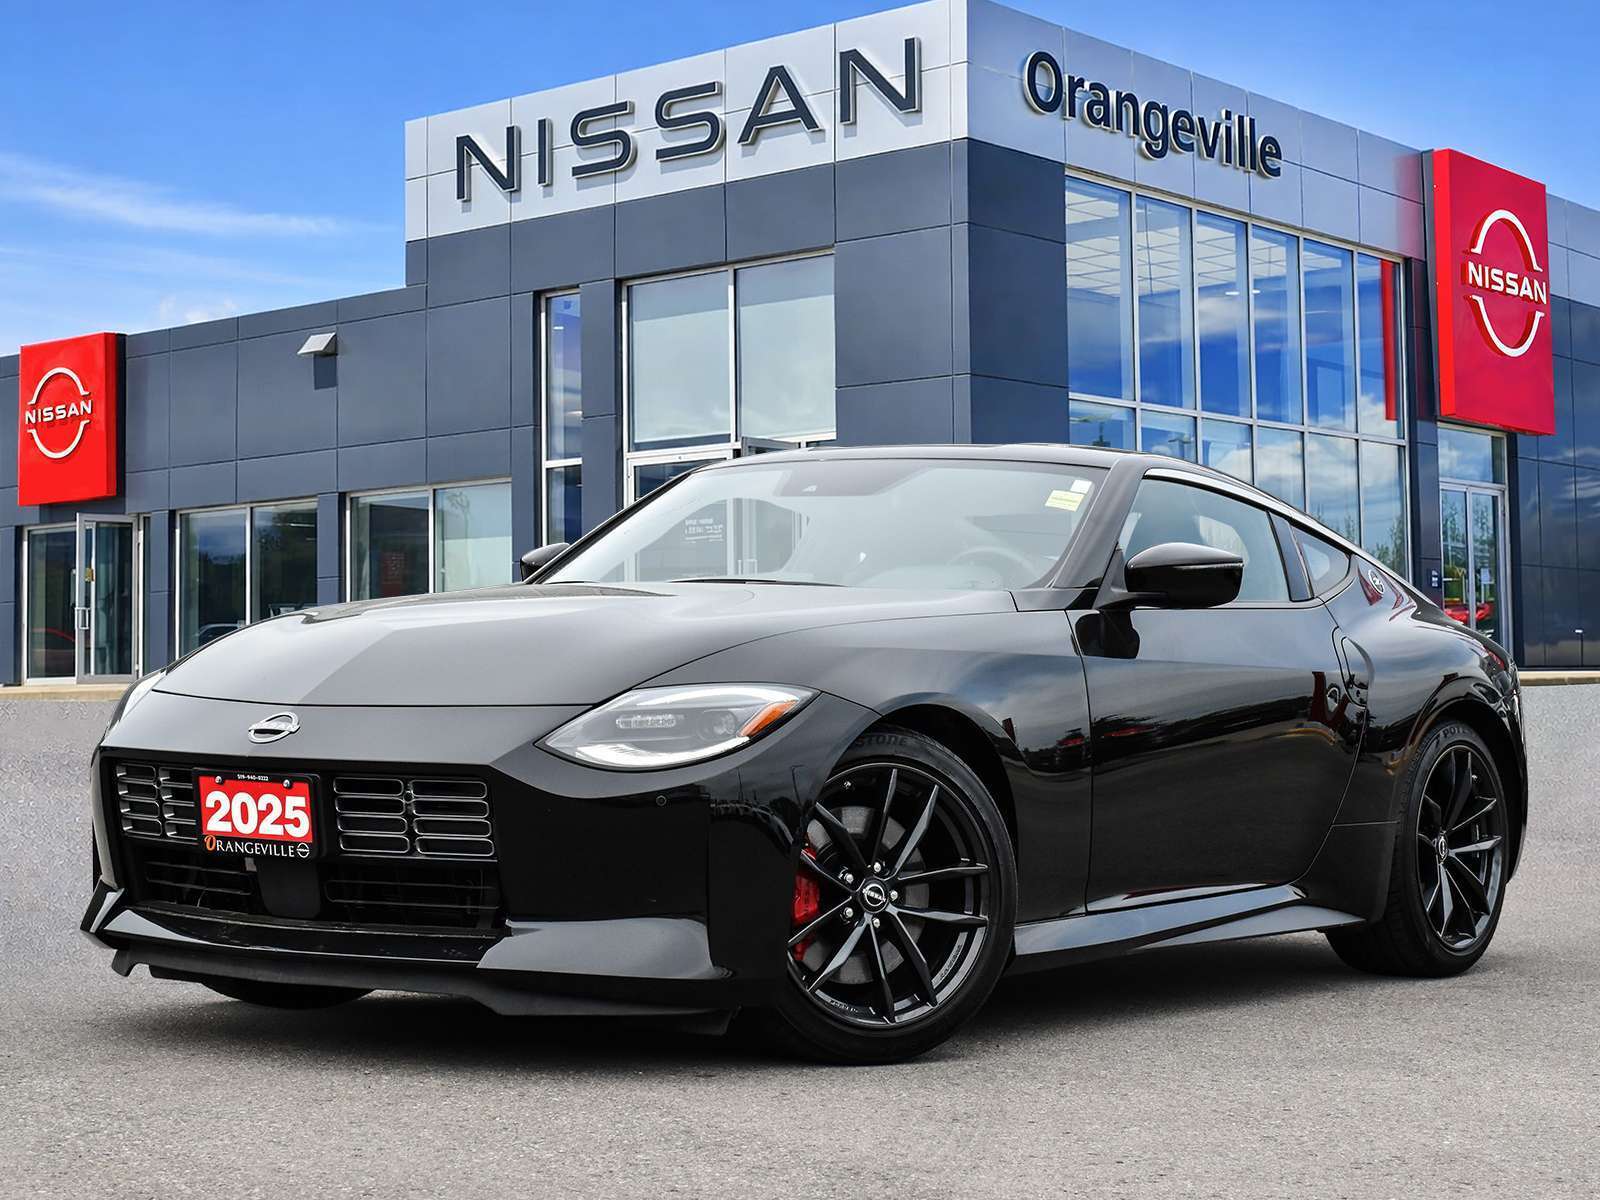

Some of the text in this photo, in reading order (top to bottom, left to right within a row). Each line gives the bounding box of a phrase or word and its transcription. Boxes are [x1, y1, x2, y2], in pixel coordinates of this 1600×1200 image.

[456, 37, 921, 201] NISSAN
[1023, 50, 1283, 179] Orangeville
[1468, 260, 1547, 304] NISSAN
[25, 399, 92, 424] NISSAN
[205, 790, 310, 838] 2025
[204, 834, 295, 857] ORANGEVILLE
